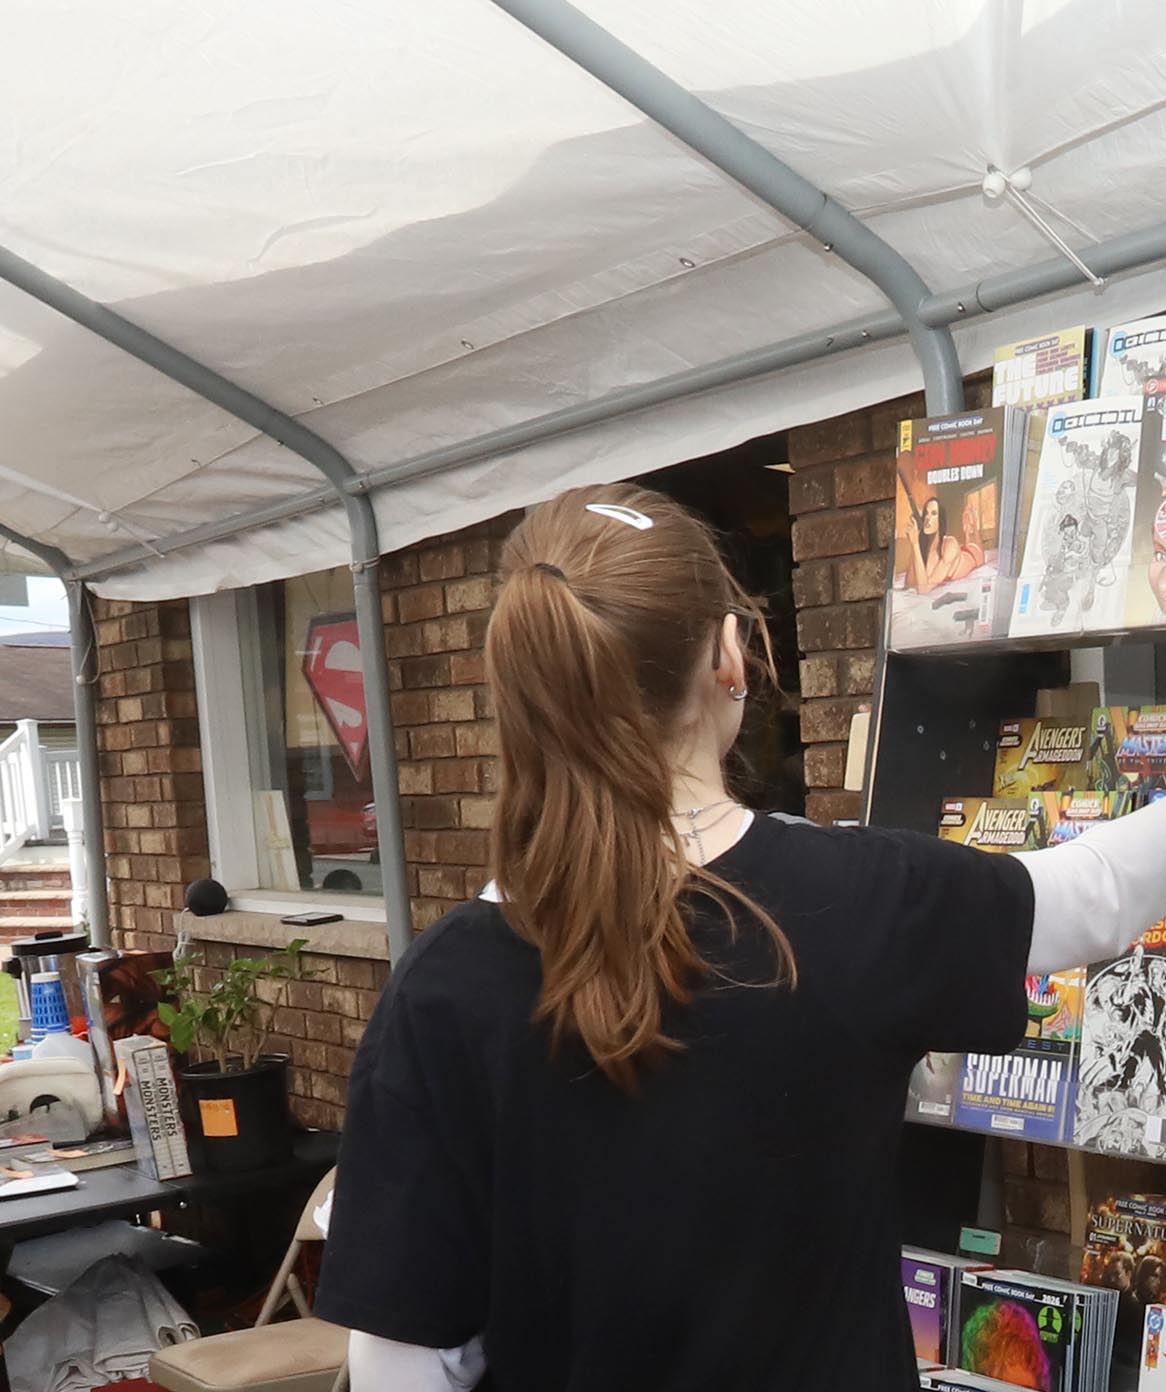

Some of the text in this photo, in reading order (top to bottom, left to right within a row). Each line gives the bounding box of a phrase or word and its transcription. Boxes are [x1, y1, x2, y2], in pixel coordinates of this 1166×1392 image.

[1019, 721, 1086, 759] AVENGERS
[963, 1053, 1062, 1104] SUPERMAN
[140, 1080, 162, 1142] MONSTERS
[155, 1077, 178, 1138] MONSTERS
